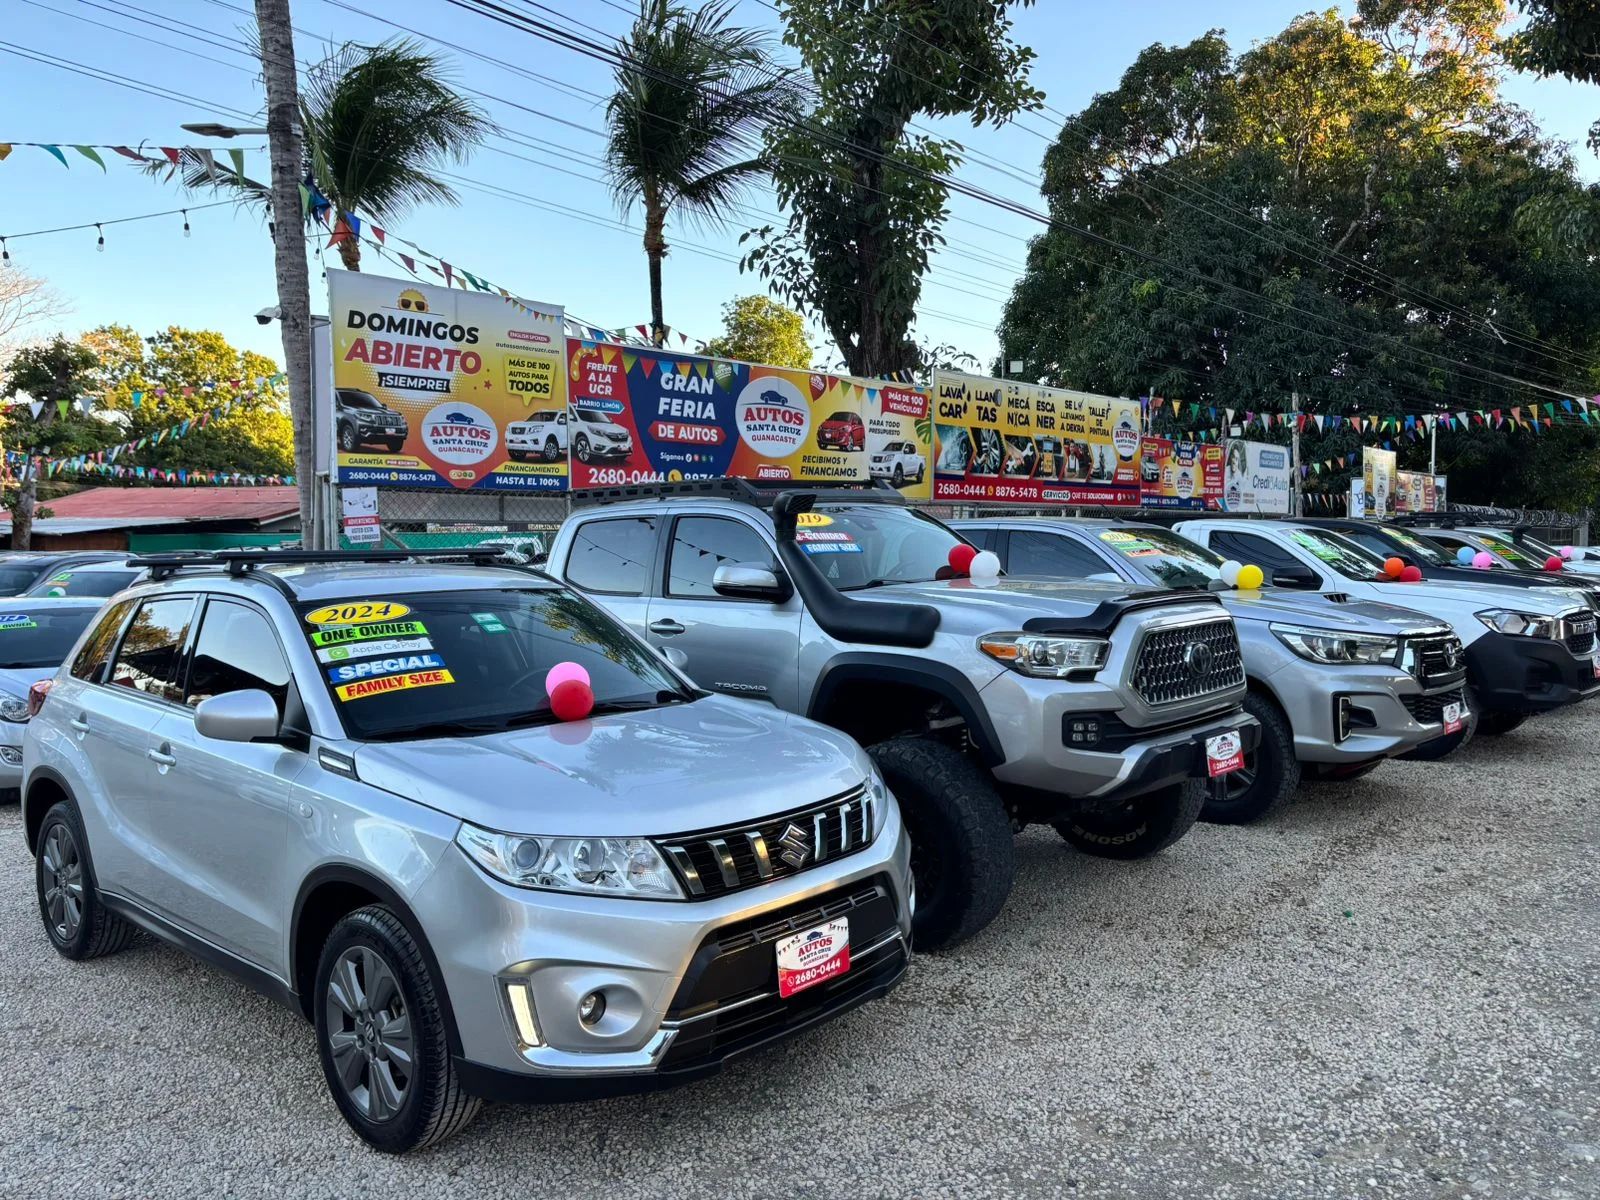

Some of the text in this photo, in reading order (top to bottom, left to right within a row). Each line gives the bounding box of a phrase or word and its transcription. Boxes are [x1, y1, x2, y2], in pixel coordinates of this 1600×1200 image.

[348, 310, 479, 344] DOMINGOS
[344, 338, 482, 374] ABIERTO
[508, 359, 525, 368] MÁS
[586, 362, 618, 373] FRENTE
[382, 374, 447, 391] ¡SIEMPRE!
[588, 374, 611, 384] A LA
[660, 372, 714, 395] GRAN
[509, 380, 549, 393] TODOS
[589, 384, 612, 396] UCR
[940, 385, 963, 400] LAVA
[579, 400, 620, 410] BARRIO LIMÓN
[911, 396, 923, 405] 100
[1008, 397, 1030, 410] MECÁ
[1037, 400, 1055, 413] ESCA
[1065, 400, 1072, 410] SE
[658, 397, 716, 420] FERIA
[939, 402, 962, 419] CAR
[976, 406, 997, 423] TAS
[744, 408, 804, 426] AUTOS
[1037, 415, 1055, 429] NER
[1061, 412, 1085, 421] LLEVAMOS
[1096, 419, 1102, 427] DE
[430, 426, 490, 440] AUTOS
[658, 424, 718, 442] DE AUTOS
[779, 425, 801, 435] CRUZ
[1061, 423, 1085, 433] A DEKRA
[1090, 427, 1110, 436] PINTURA
[752, 434, 796, 444] GUANACASTE
[1115, 431, 1137, 440] AUTOS
[438, 447, 484, 455] GUANACASTE
[660, 452, 684, 461] Síganos
[802, 455, 841, 464] RECIBIMOS
[504, 465, 559, 473] FINANCIAMIENTO
[759, 468, 789, 478] ABIERTO
[801, 466, 857, 477] FINANCIAMOS
[399, 473, 436, 481] 8876-5478
[496, 476, 525, 485] HASTA
[589, 469, 665, 484] 2680-0444
[938, 483, 1037, 498] 2680-0444 8876-5478
[325, 604, 391, 622] 2024
[321, 623, 415, 642] ONE OWNER
[353, 641, 420, 654] Apple CarPlay
[339, 655, 439, 680] SPECIAL
[346, 672, 444, 696] FAMILY SIZE
[715, 682, 768, 692] TACOMA
[798, 937, 832, 957] AUTOS
[795, 958, 840, 985] 2680-0444
